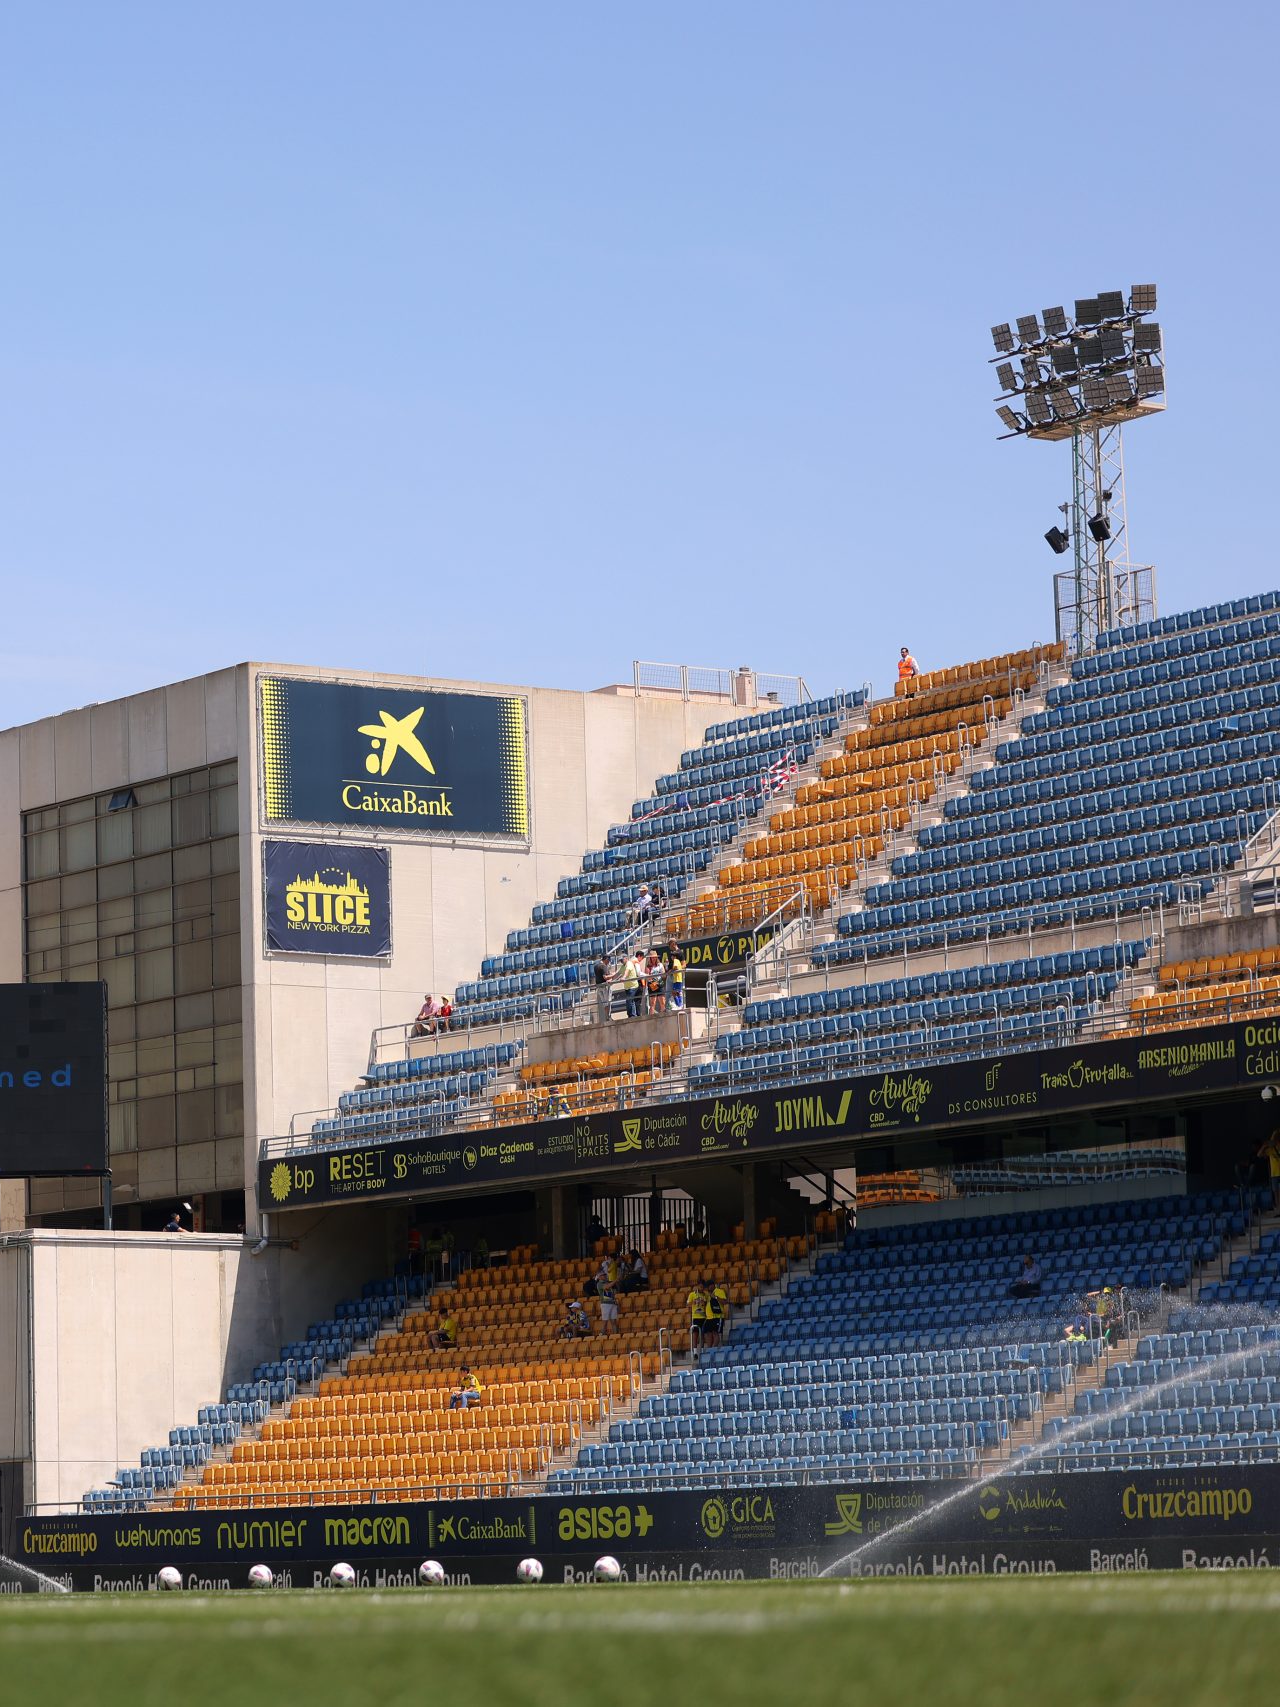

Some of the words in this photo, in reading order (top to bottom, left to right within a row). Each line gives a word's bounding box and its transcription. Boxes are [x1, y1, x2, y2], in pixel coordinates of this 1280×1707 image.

[342, 785, 454, 816] CaixaBank
[286, 891, 371, 926] SLICE
[287, 922, 311, 931] NEW
[313, 923, 341, 933] YORK
[342, 925, 371, 934] PIZZA
[948, 1102, 961, 1115] DS
[964, 1091, 1038, 1112] CONSULTORES
[644, 1114, 688, 1131] Diputación
[870, 1113, 884, 1123] CBD
[548, 1134, 574, 1146] ESTUDIO
[576, 1125, 591, 1136] NO
[577, 1134, 609, 1148] LIMITS
[645, 1136, 655, 1149] de
[658, 1132, 680, 1147] Cádiz
[500, 1141, 535, 1155] Cadenas
[577, 1145, 610, 1158] SPACES
[701, 1136, 716, 1147] CBD
[329, 1150, 386, 1182] RESET
[500, 1154, 516, 1164] CASH
[294, 1164, 315, 1194] bp
[422, 1165, 446, 1176] HOTELS
[366, 1178, 387, 1190] BODY
[731, 1495, 776, 1523] GICA
[866, 1491, 924, 1512] Diputación
[1122, 1484, 1252, 1521] Cruzcampo
[217, 1519, 308, 1549] numier
[324, 1516, 411, 1546] macron
[458, 1515, 527, 1541] CaixaBank
[867, 1514, 881, 1533] de
[23, 1526, 98, 1557] Cruzcampo
[115, 1523, 202, 1548] wehumans
[770, 1556, 819, 1579] Barceló
[1090, 1549, 1148, 1572] Barceló
